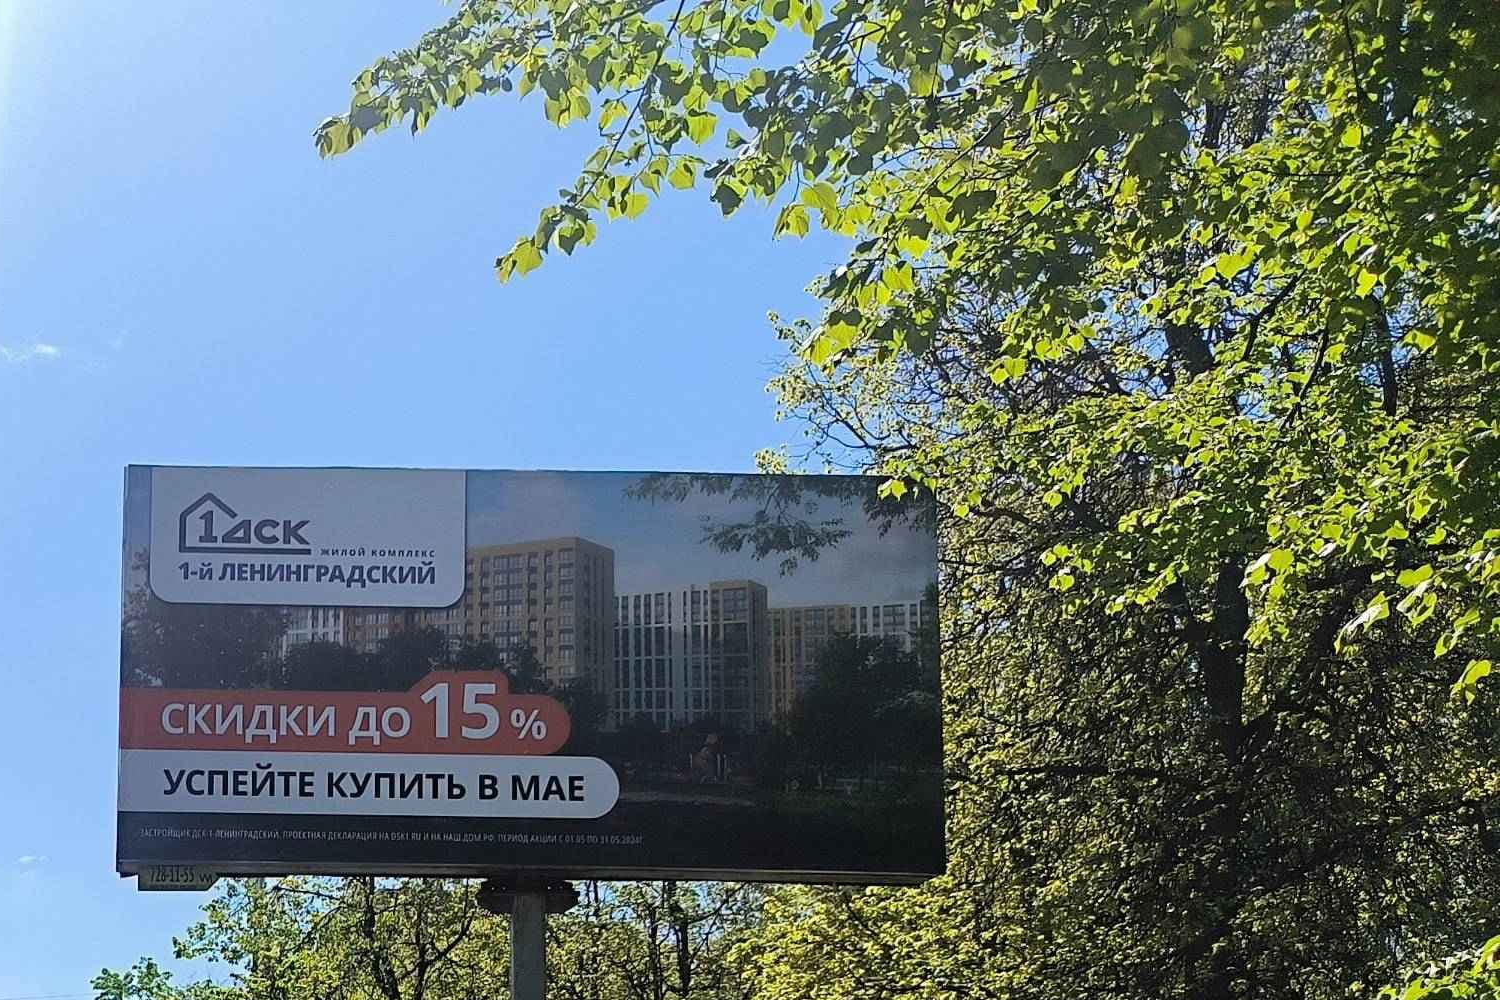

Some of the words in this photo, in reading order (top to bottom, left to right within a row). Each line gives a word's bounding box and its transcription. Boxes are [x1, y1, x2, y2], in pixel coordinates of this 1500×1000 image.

[320, 547, 366, 557] ЖИЛОЙ
[371, 548, 436, 558] КОМПЛЕКС
[178, 561, 214, 581] 1-й
[218, 561, 436, 588] ЛЕНИНГРАДСКИЙ
[161, 703, 337, 744] СКИДКИ
[348, 705, 411, 746] ДО
[420, 681, 501, 740] 15
[163, 763, 316, 799] УСПЕЙТЕ
[326, 771, 466, 803] КУПИТЬ
[478, 774, 499, 800] В
[512, 775, 585, 802] МАЕ
[282, 829, 326, 841] ПРОЕКТНАЯ
[328, 830, 378, 841] ДЕКЛАРАЦИЯ
[379, 831, 390, 841] НА
